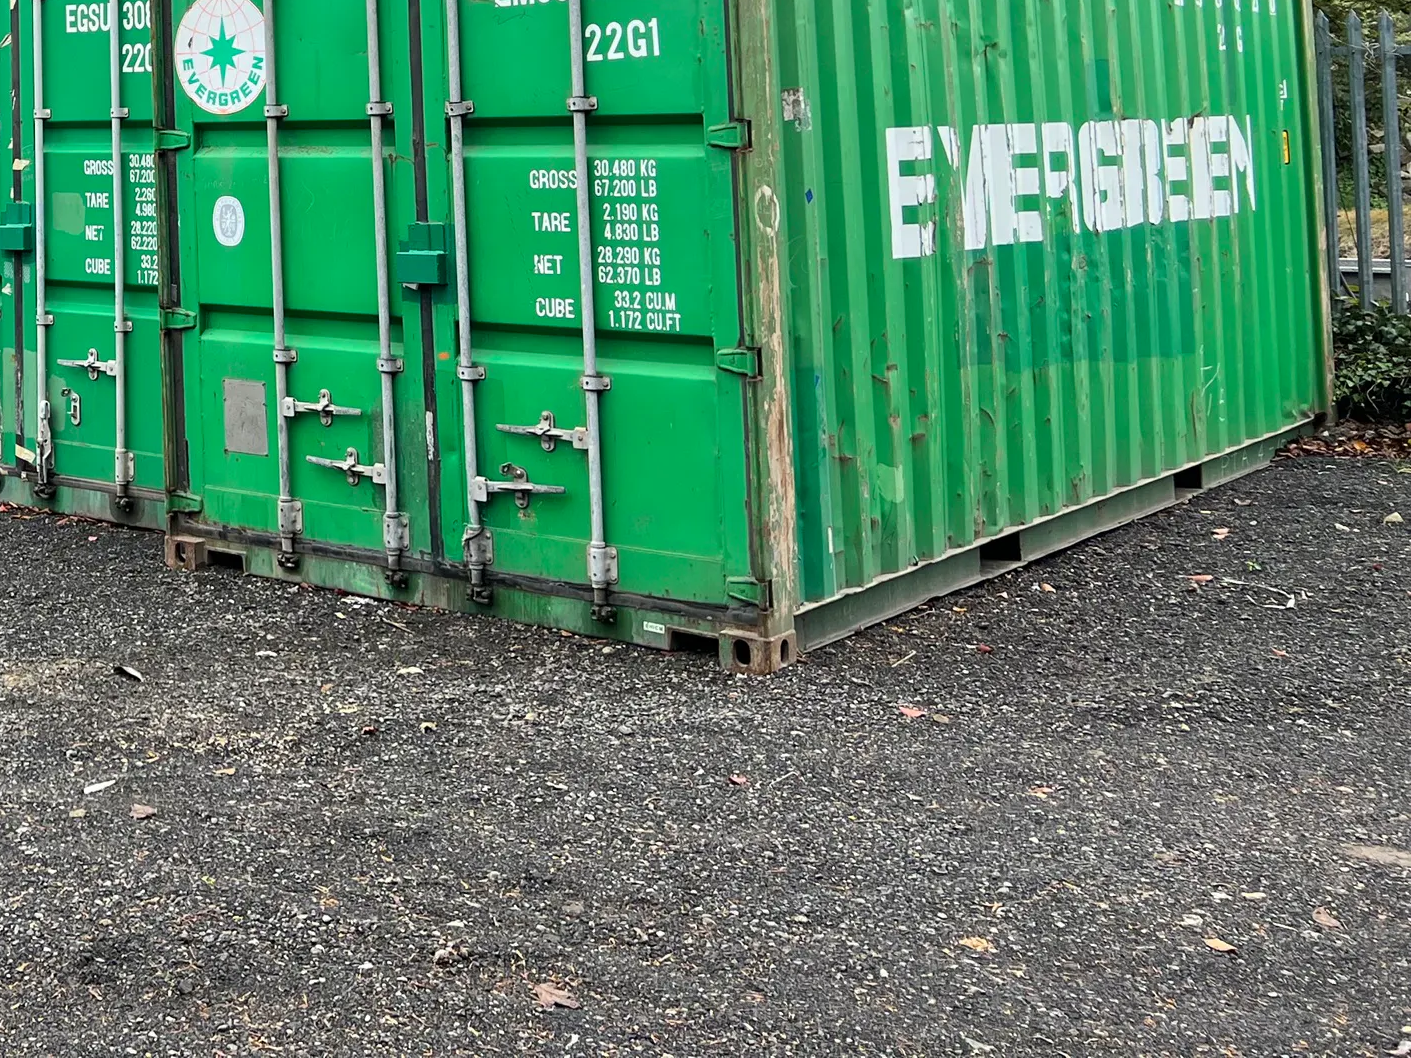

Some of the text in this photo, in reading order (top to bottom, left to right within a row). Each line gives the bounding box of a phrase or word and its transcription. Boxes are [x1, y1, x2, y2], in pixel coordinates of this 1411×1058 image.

[65, 3, 110, 33] EGSU
[585, 18, 660, 62] 22G1
[182, 56, 264, 107] EVERGREEN
[84, 160, 114, 176] GROSS
[594, 159, 657, 177] 30.480 KG
[529, 170, 578, 189] GROSS
[594, 180, 658, 197] 67.200 LB
[85, 193, 109, 208] TARE
[531, 212, 571, 232] TARE
[603, 203, 659, 222] 2.190 KG
[85, 225, 104, 241] NET
[131, 221, 157, 235] 28.220
[604, 223, 660, 241] 4.830 LB
[131, 237, 158, 251] 62.220
[141, 255, 158, 269] 33.2
[533, 255, 563, 275] NET
[597, 246, 661, 265] 28.290 KG
[85, 258, 111, 274] CUBE
[598, 266, 662, 285] 62.370 LB
[137, 270, 159, 285] 1.172
[535, 298, 576, 318] CUBE
[614, 291, 676, 311] 33.2 CU.M
[609, 310, 682, 331] 1.172 CU.FT
